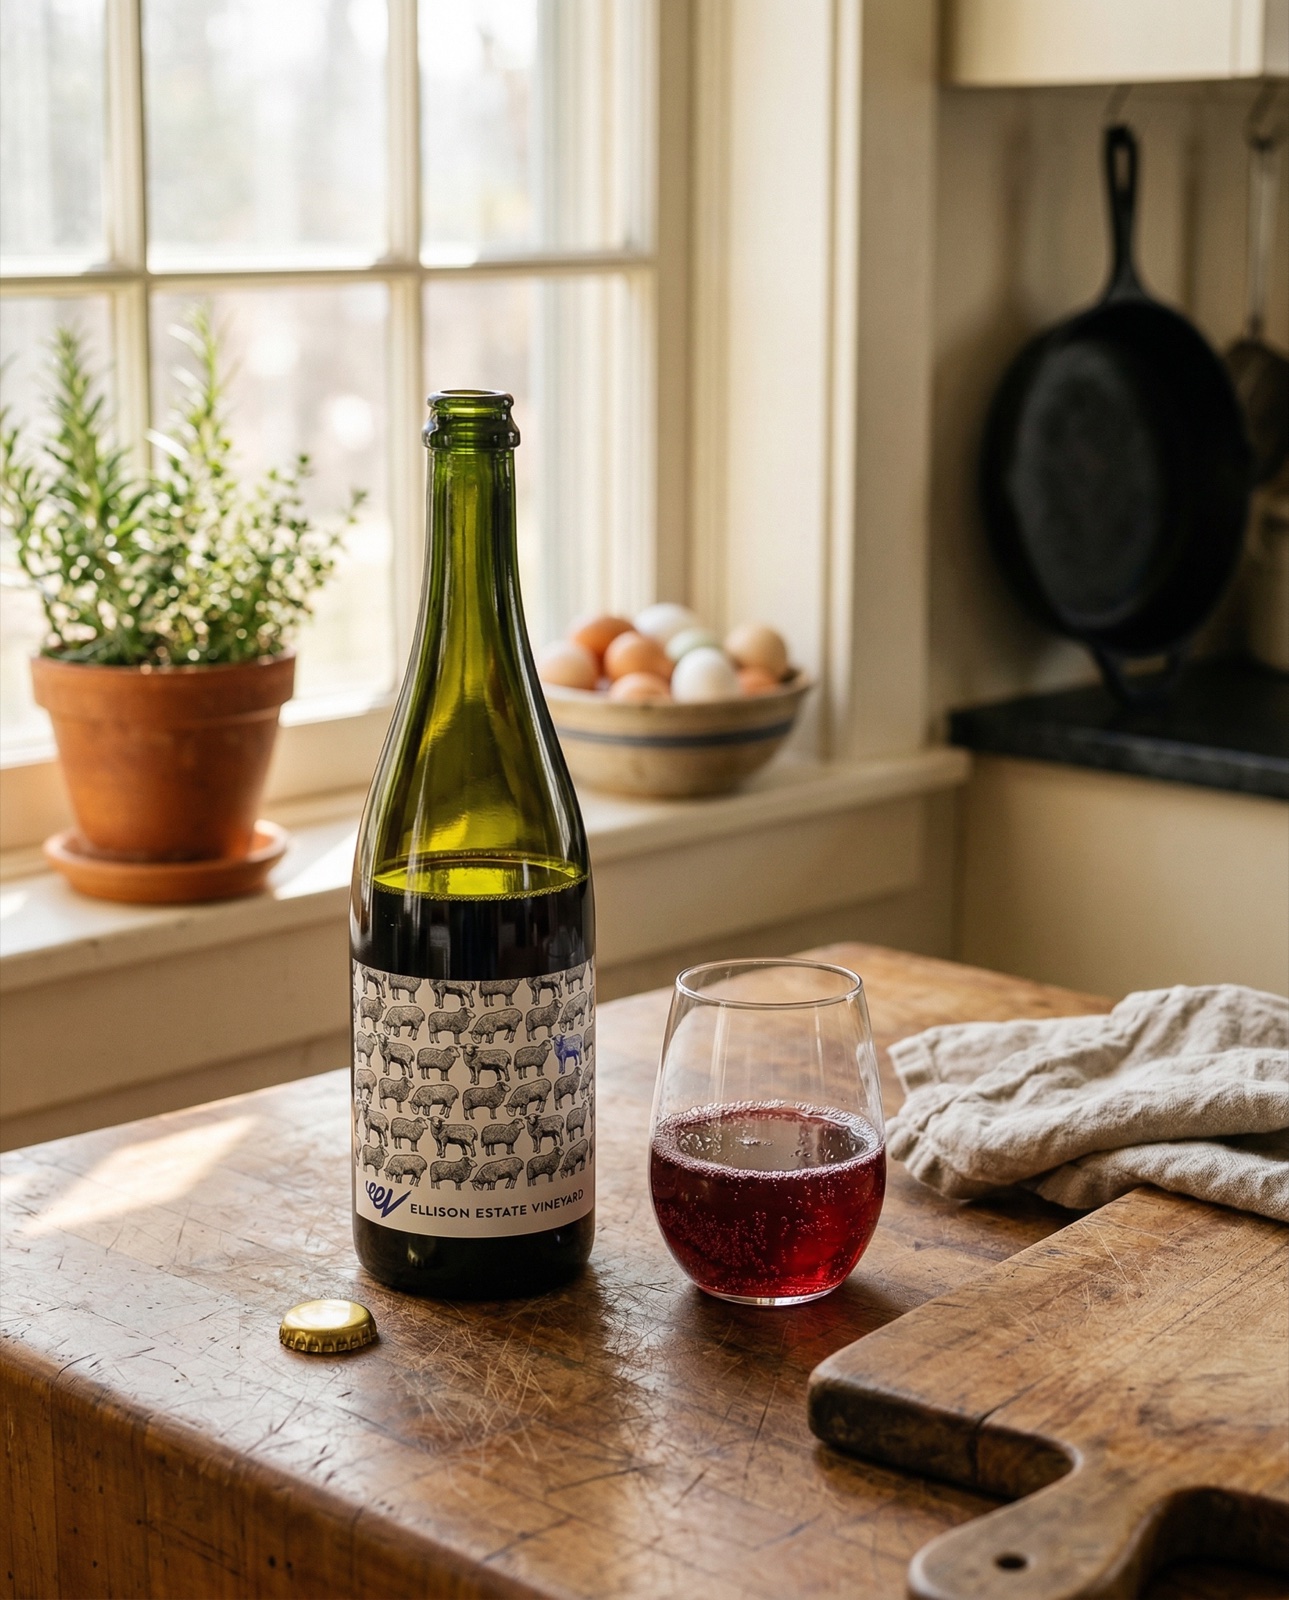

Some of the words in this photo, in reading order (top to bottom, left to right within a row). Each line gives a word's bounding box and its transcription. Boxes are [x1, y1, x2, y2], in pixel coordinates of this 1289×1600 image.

[410, 1204, 470, 1218] ELLISON
[476, 1205, 527, 1218] ESTATE
[532, 1189, 584, 1213] VINEYARD
